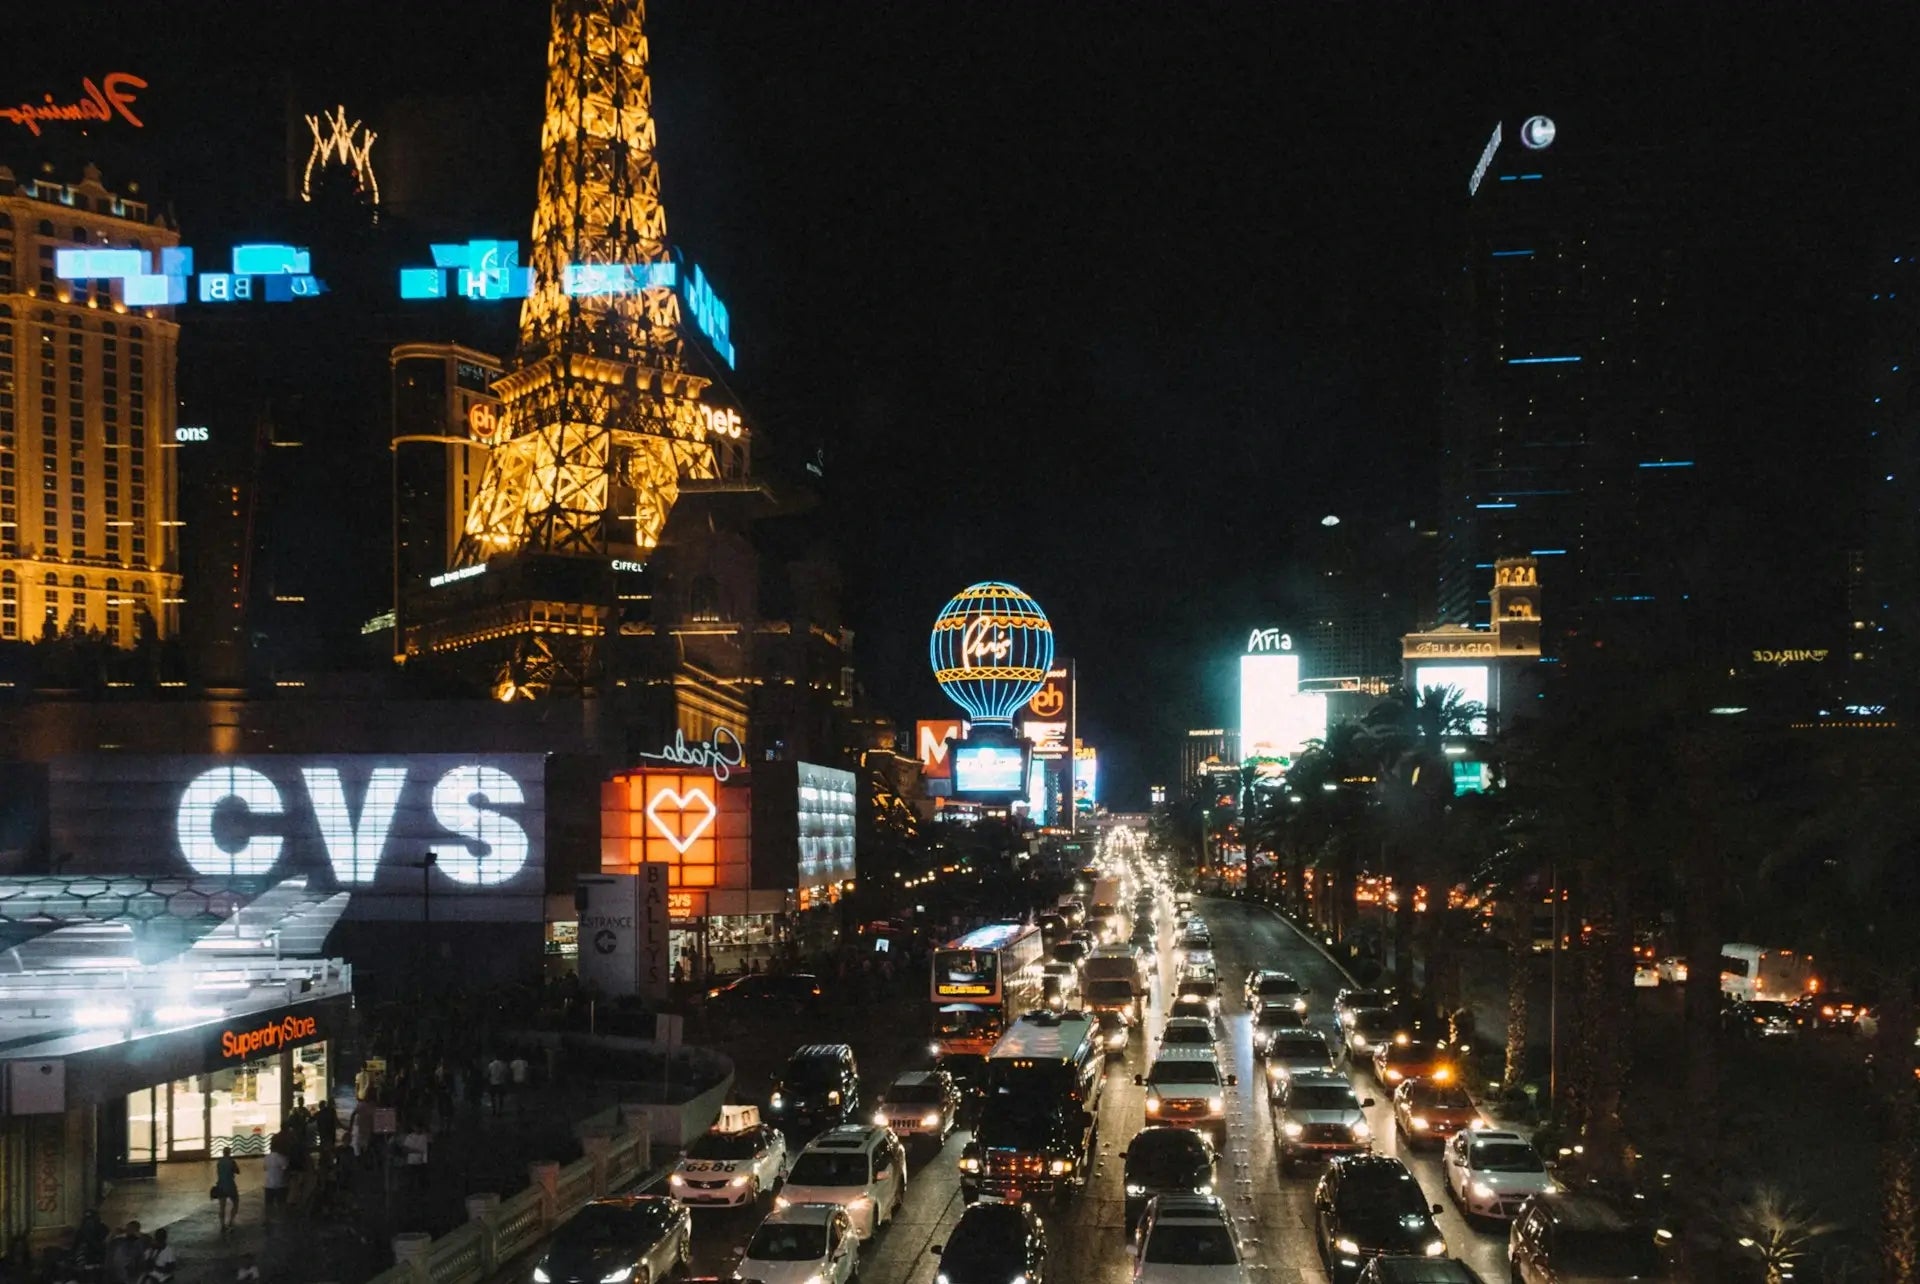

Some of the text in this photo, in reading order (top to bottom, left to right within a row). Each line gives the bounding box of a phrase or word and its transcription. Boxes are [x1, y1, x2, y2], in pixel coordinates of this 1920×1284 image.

[175, 427, 209, 441] ons
[1248, 628, 1292, 652] Aria
[177, 766, 529, 885] CVS
